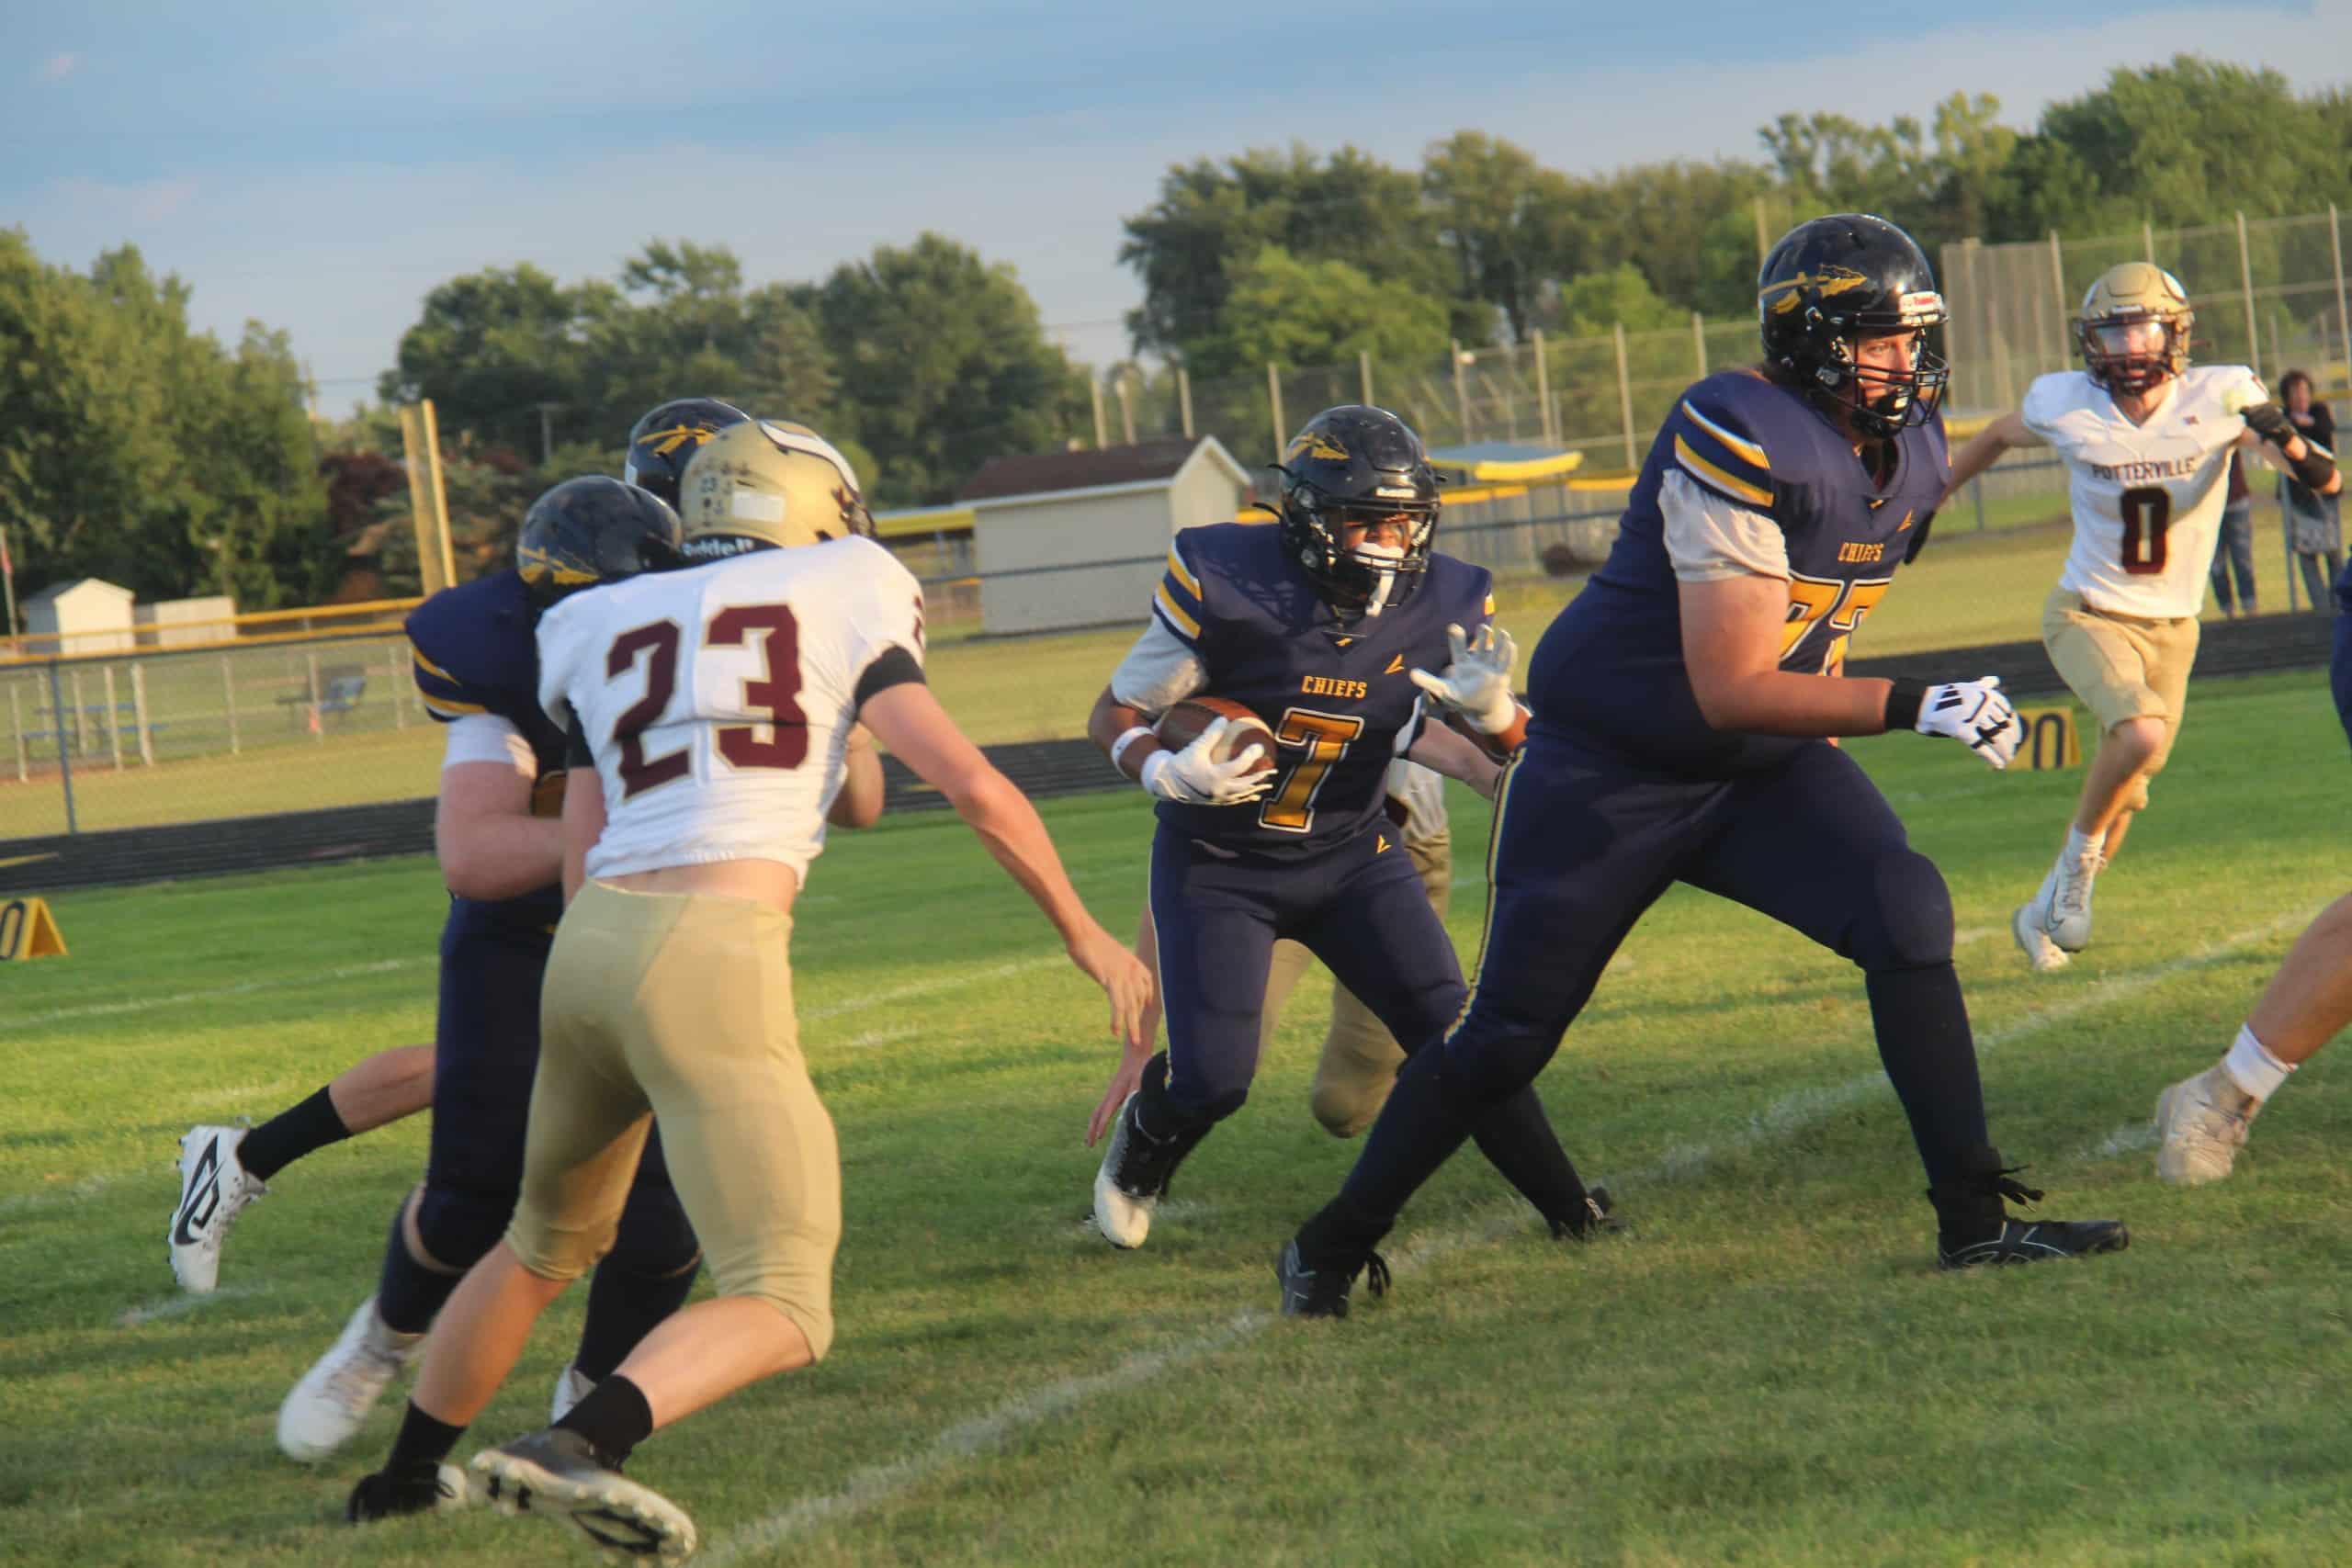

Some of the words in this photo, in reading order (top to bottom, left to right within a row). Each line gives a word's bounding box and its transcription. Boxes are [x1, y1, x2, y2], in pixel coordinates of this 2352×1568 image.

[2091, 457, 2195, 480] POTTERVILLE
[2120, 486, 2172, 575] 0
[604, 600, 809, 807] 23
[1301, 675, 1368, 699] CHIEFS
[1258, 706, 1365, 834] 7
